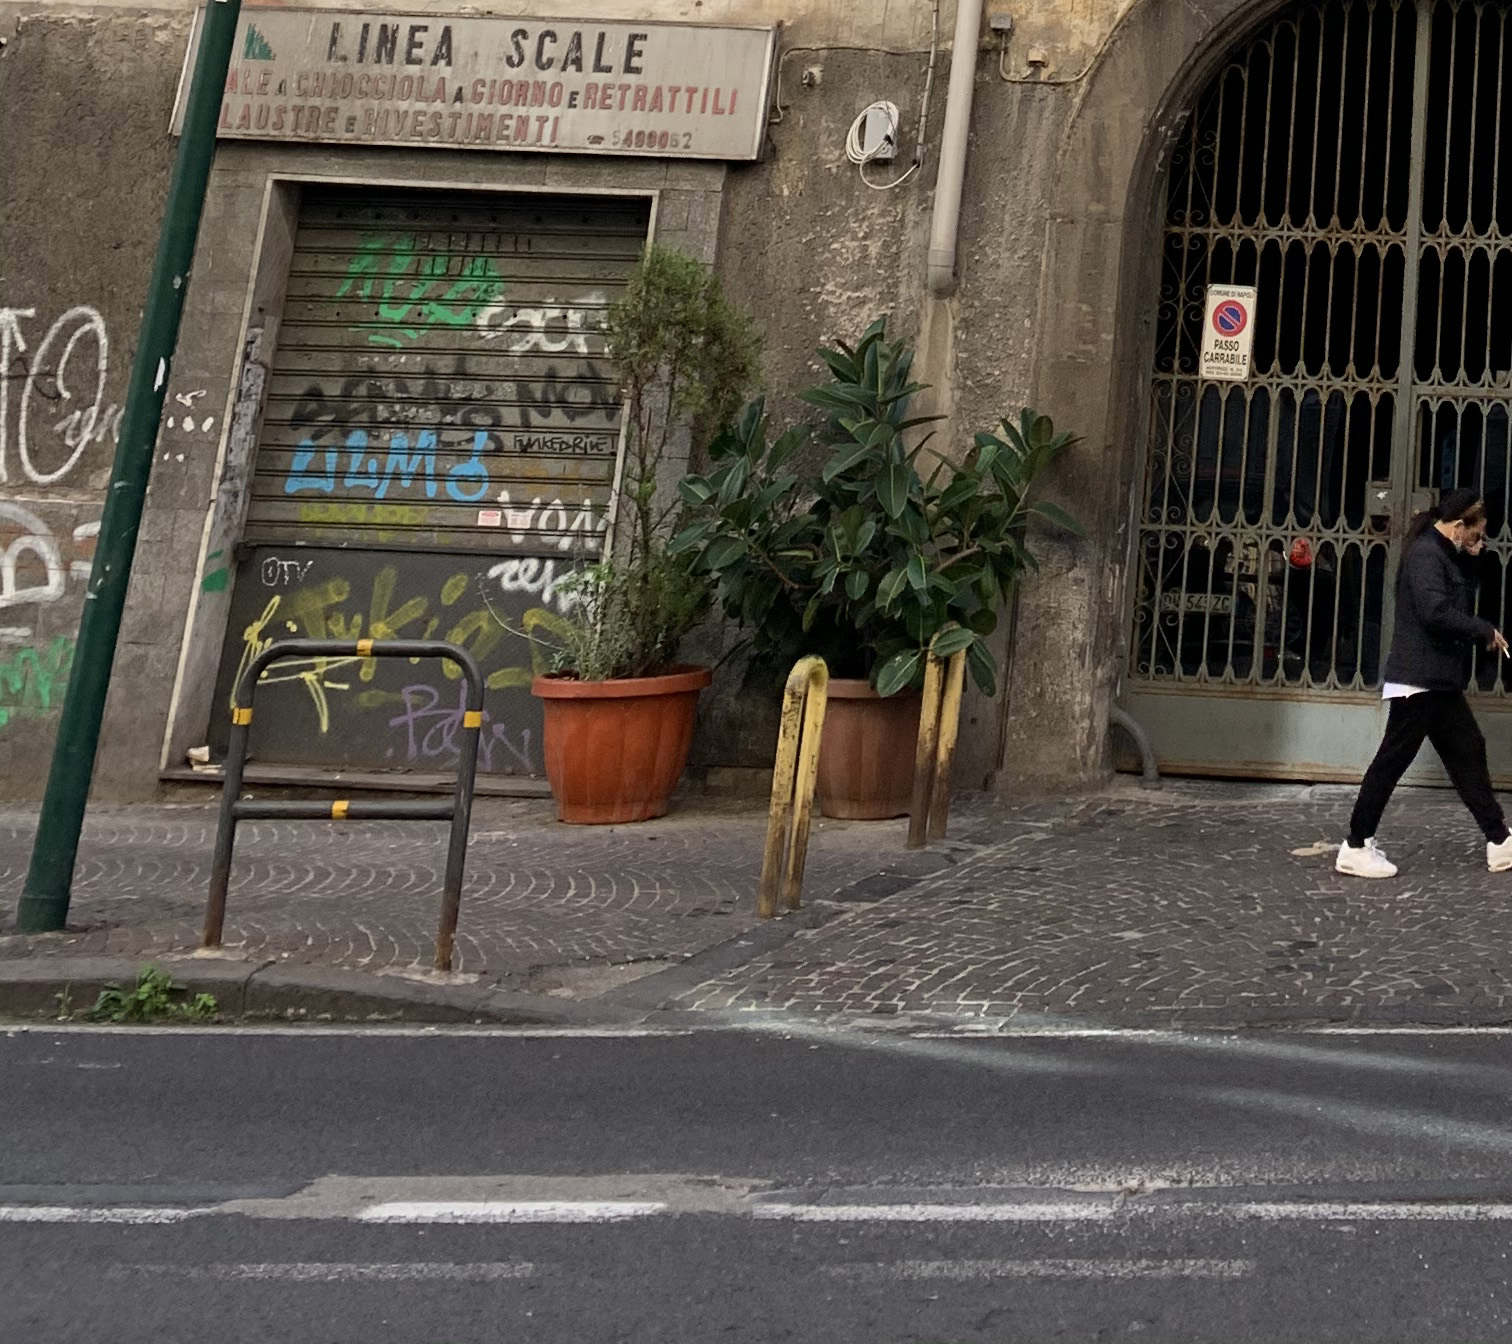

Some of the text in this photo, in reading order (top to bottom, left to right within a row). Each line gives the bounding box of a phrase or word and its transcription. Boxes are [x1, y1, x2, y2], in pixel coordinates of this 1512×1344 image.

[327, 22, 647, 74] LINEA SCALE
[225, 68, 738, 115] ALE A CHIOCCIOLA A GIORNO E RETRATTILI
[220, 102, 340, 133] LAUSTRE
[345, 115, 358, 133] E
[362, 107, 560, 144] RIVESTIMENTI
[1203, 351, 1247, 365] CARRABILE
[1214, 339, 1239, 351] PASSO
